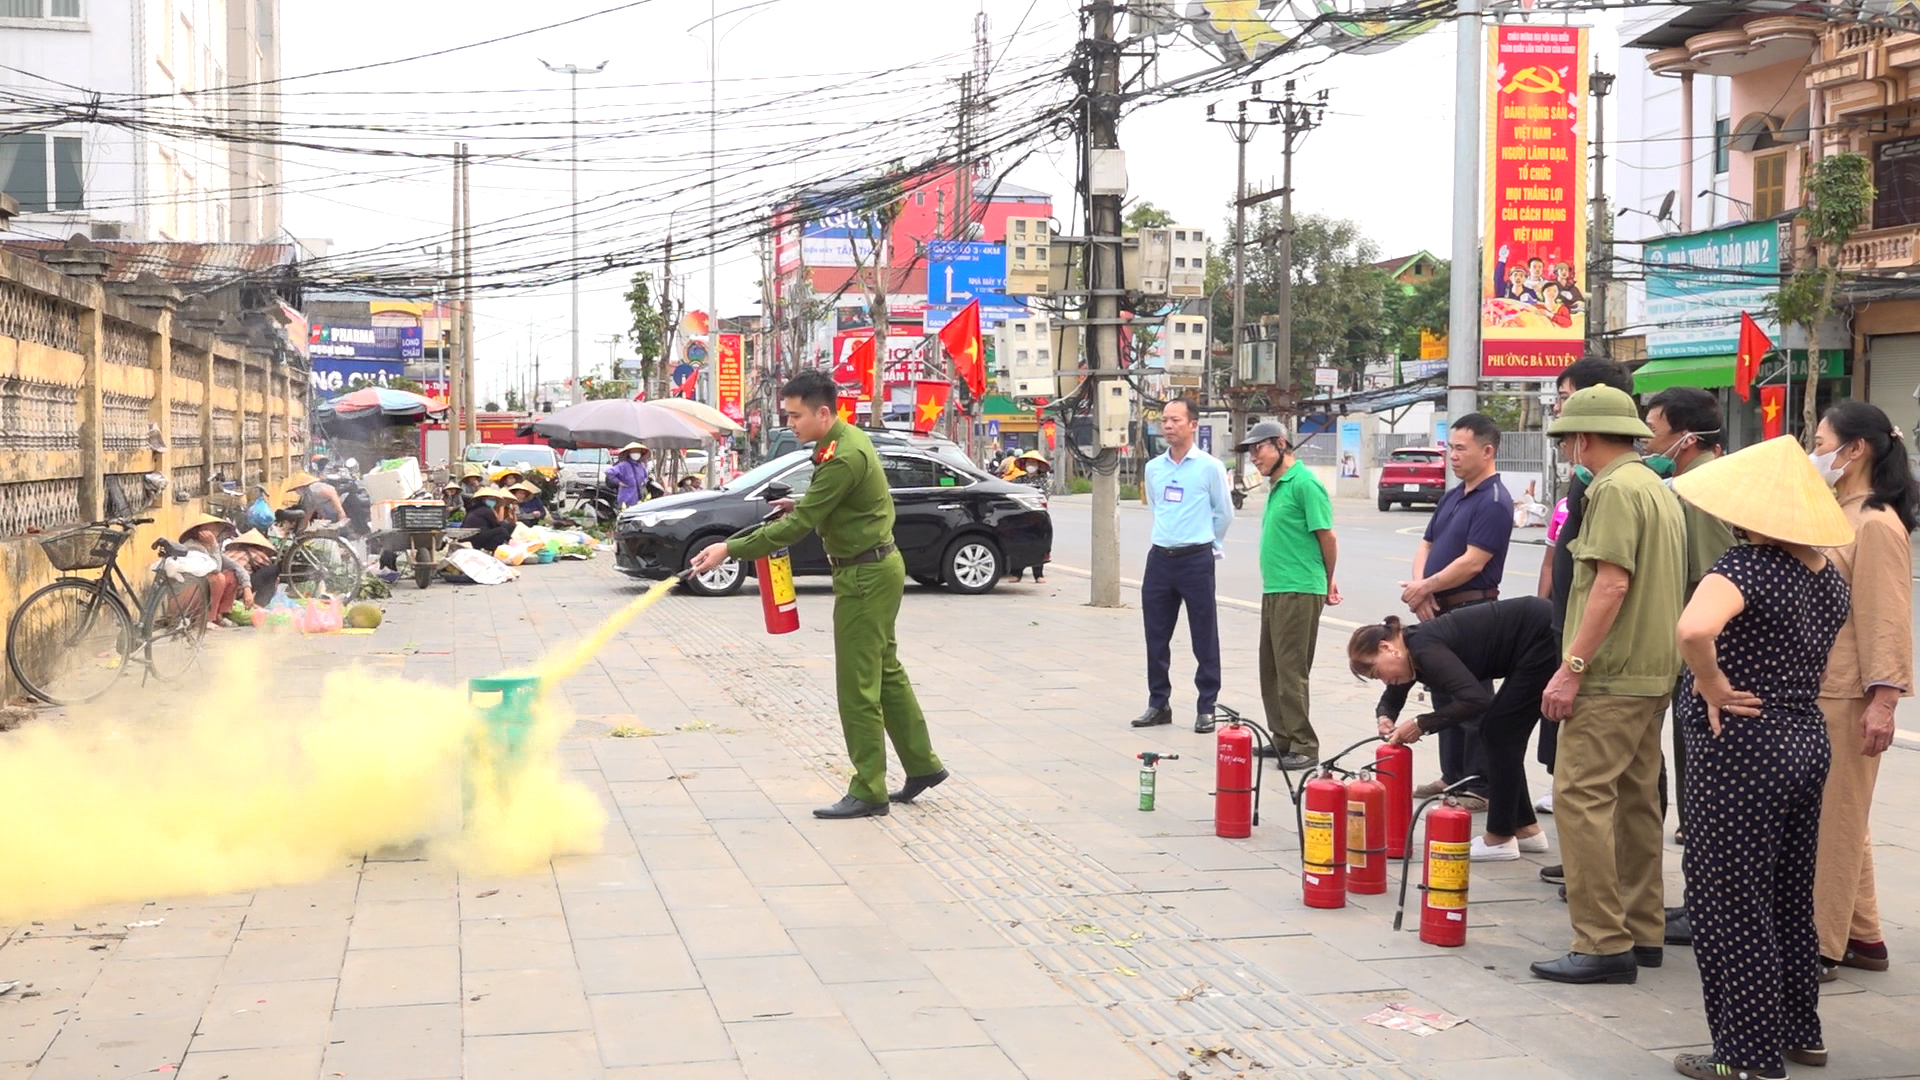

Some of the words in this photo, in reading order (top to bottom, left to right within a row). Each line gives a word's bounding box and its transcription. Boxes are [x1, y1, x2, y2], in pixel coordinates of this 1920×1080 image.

[1504, 101, 1526, 119] ĐẢNG
[1528, 104, 1549, 122] CỘNG
[1550, 102, 1568, 120] SẢN
[1514, 124, 1531, 142] VIỆT
[1532, 127, 1551, 140] NAM
[1502, 144, 1526, 160] NGƯỜI
[1528, 144, 1548, 160] LÃNH
[1530, 164, 1551, 180] CHỨC
[1506, 187, 1521, 203] MỌI
[1502, 202, 1518, 221] CỦA
[1520, 205, 1541, 221] CÁCH
[1542, 208, 1566, 224] MẠNG
[1514, 226, 1531, 244] VIỆT
[1688, 238, 1719, 268] THUỐC
[1721, 233, 1742, 266] BẢO
[1744, 240, 1760, 265] AN
[1762, 239, 1770, 262] 2
[330, 328, 376, 344] PHARMA
[402, 338, 419, 346] LONG
[1487, 352, 1528, 367] PHƯỜNG
[1530, 352, 1543, 367] BÁ
[310, 370, 343, 391] NG
